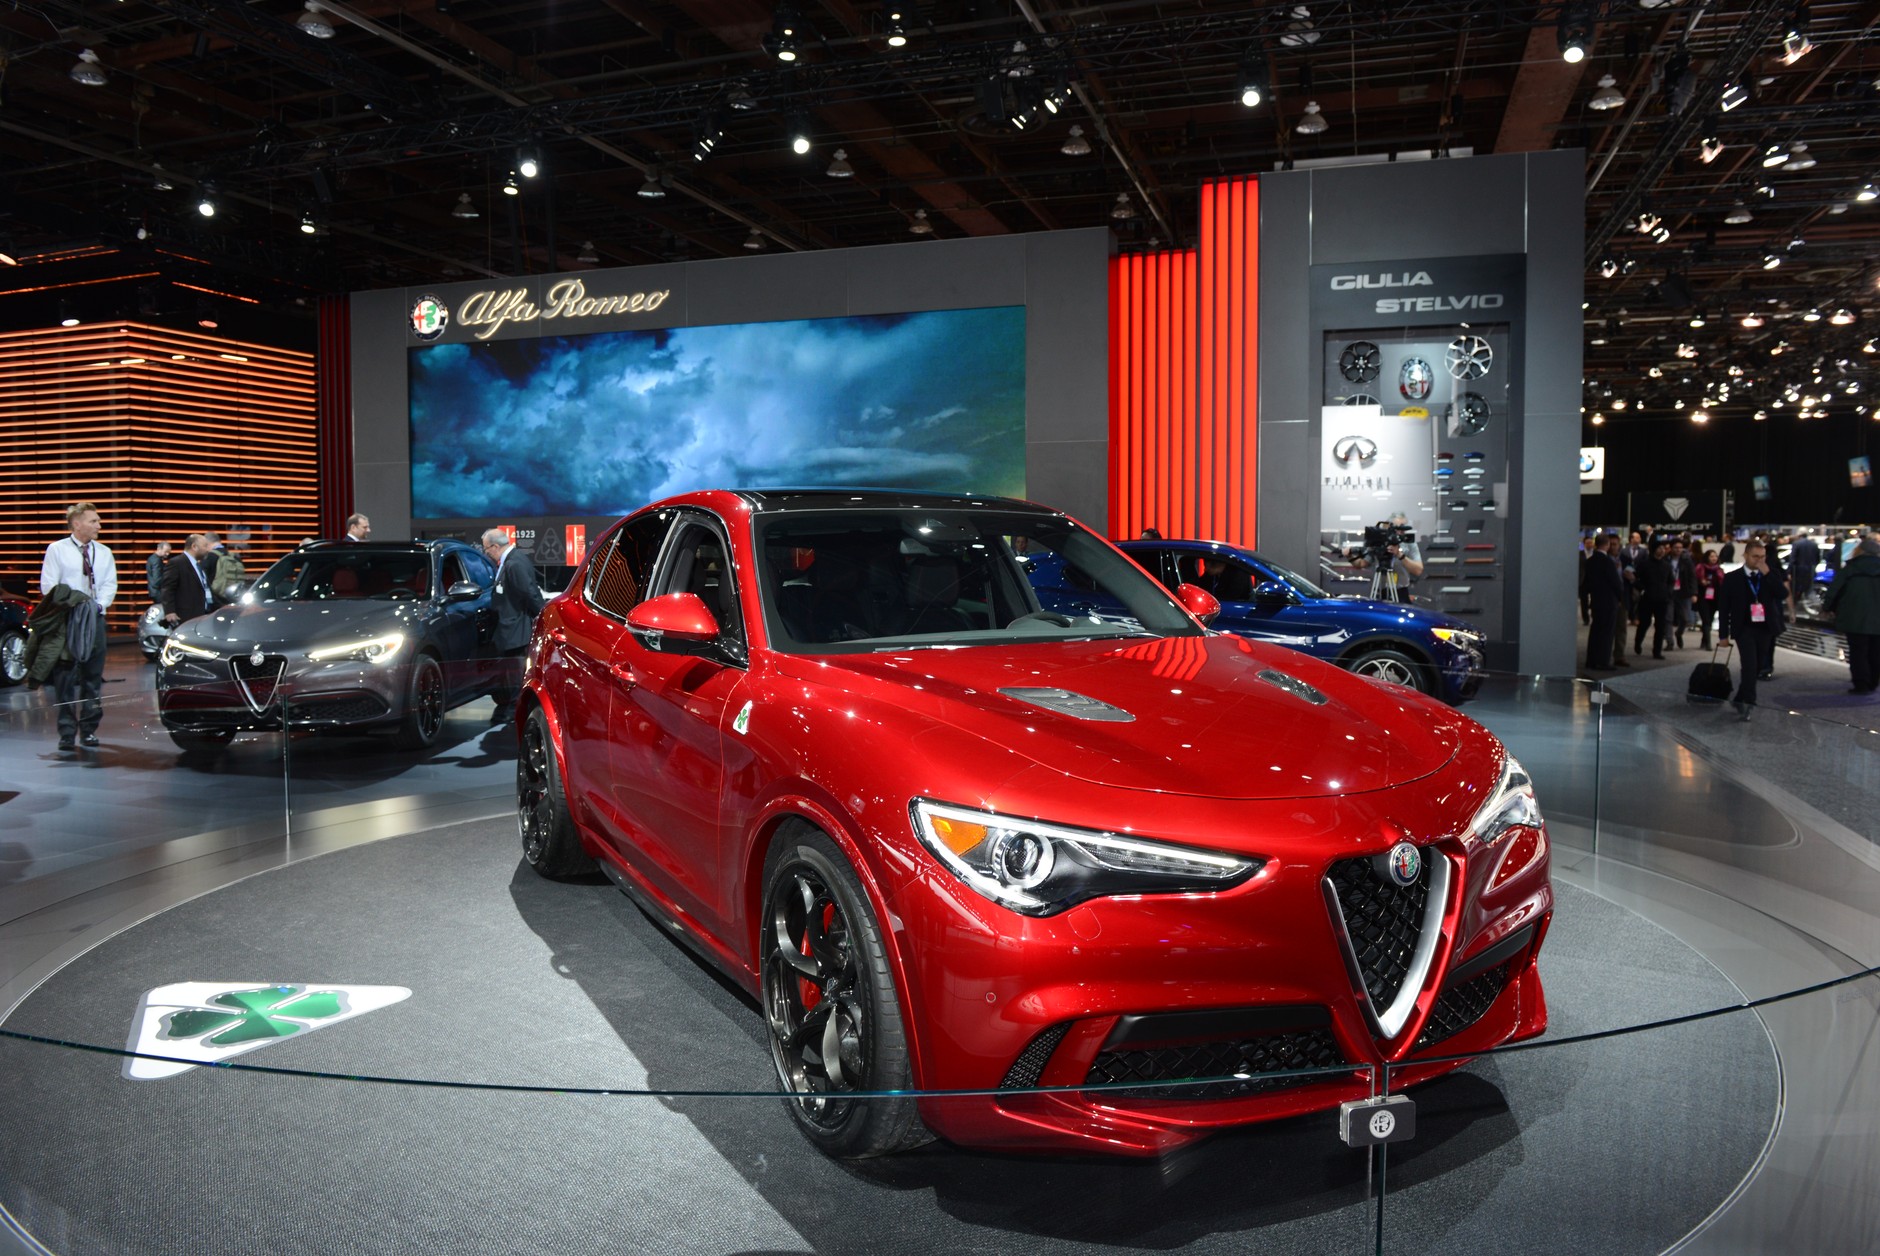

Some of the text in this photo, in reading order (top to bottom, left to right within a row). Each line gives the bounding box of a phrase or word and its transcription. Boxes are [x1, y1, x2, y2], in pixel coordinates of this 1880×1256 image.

[1330, 271, 1434, 291] GIULIA
[456, 287, 540, 340] Alfa
[540, 278, 670, 318] Romeo
[1375, 294, 1504, 314] STELVIO
[516, 529, 535, 538] 1923
